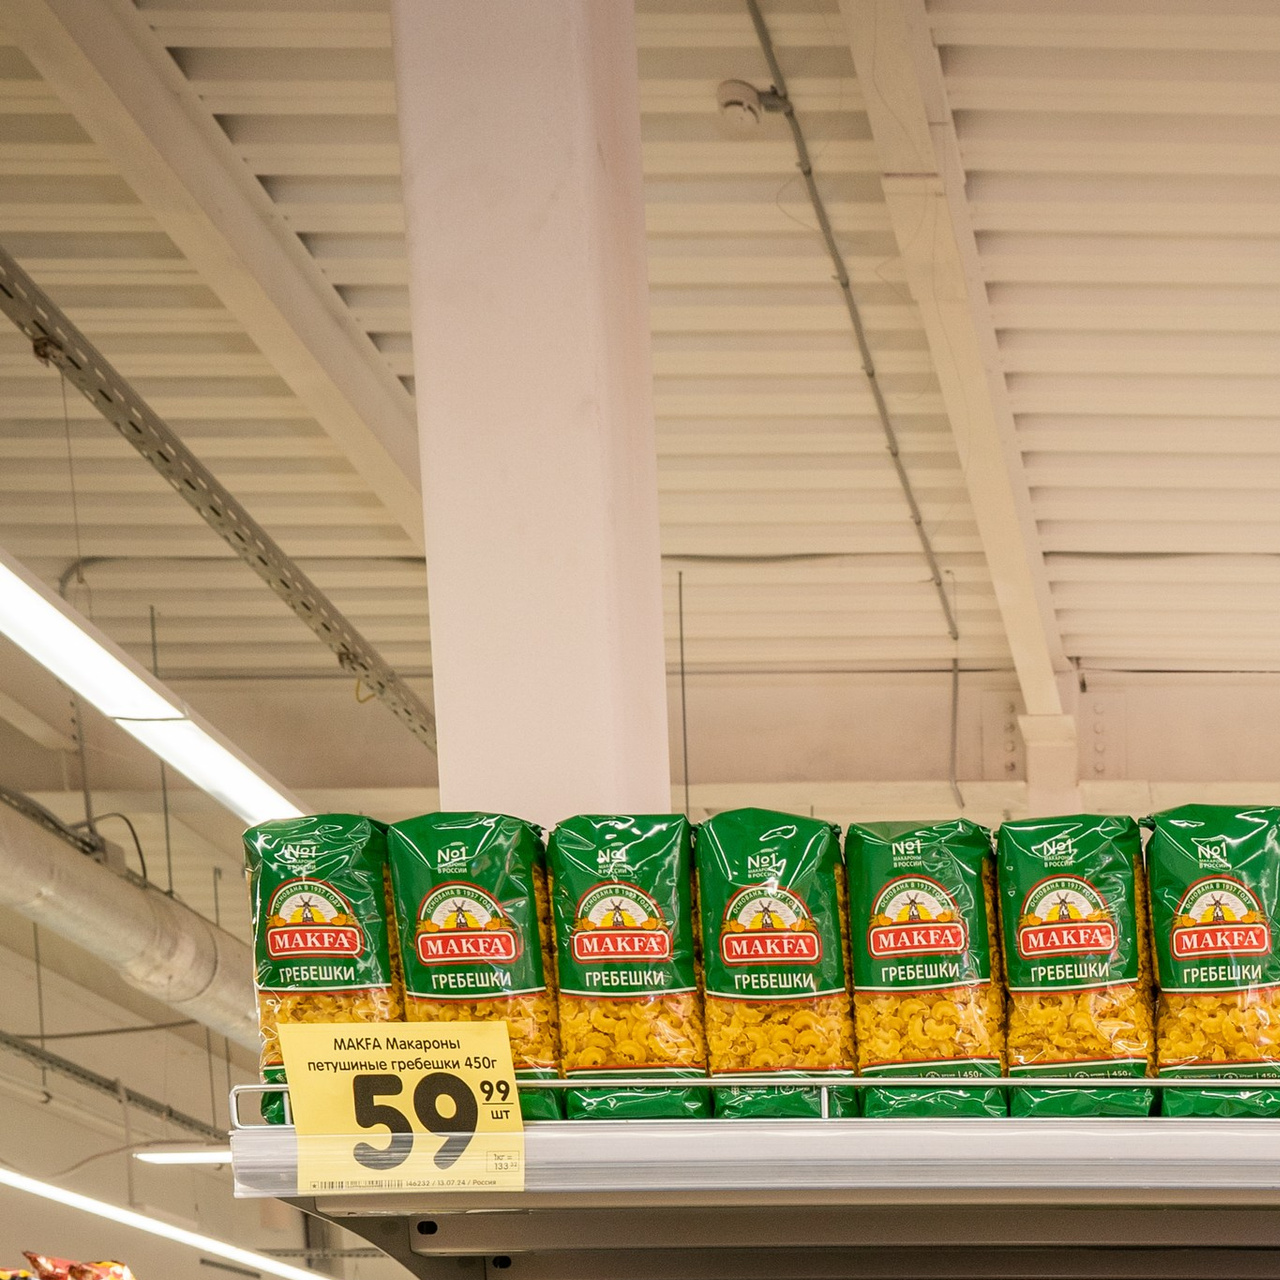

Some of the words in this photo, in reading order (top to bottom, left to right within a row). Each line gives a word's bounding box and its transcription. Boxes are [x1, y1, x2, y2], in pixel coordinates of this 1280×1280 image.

[731, 938, 809, 956] MAKFA
[878, 929, 956, 948] MAKFA
[734, 972, 814, 990] ГРЕБЕШКИ
[881, 962, 960, 982] ГРЕБЕШКИ
[334, 1038, 382, 1050] MAKFA
[386, 1037, 460, 1053] Макароны
[308, 1060, 387, 1072] петушиные
[391, 1058, 460, 1072] гребешки
[465, 1057, 496, 1069] 450г
[353, 1072, 478, 1171] 59
[480, 1080, 510, 1101] 99
[491, 1110, 510, 1120] шт
